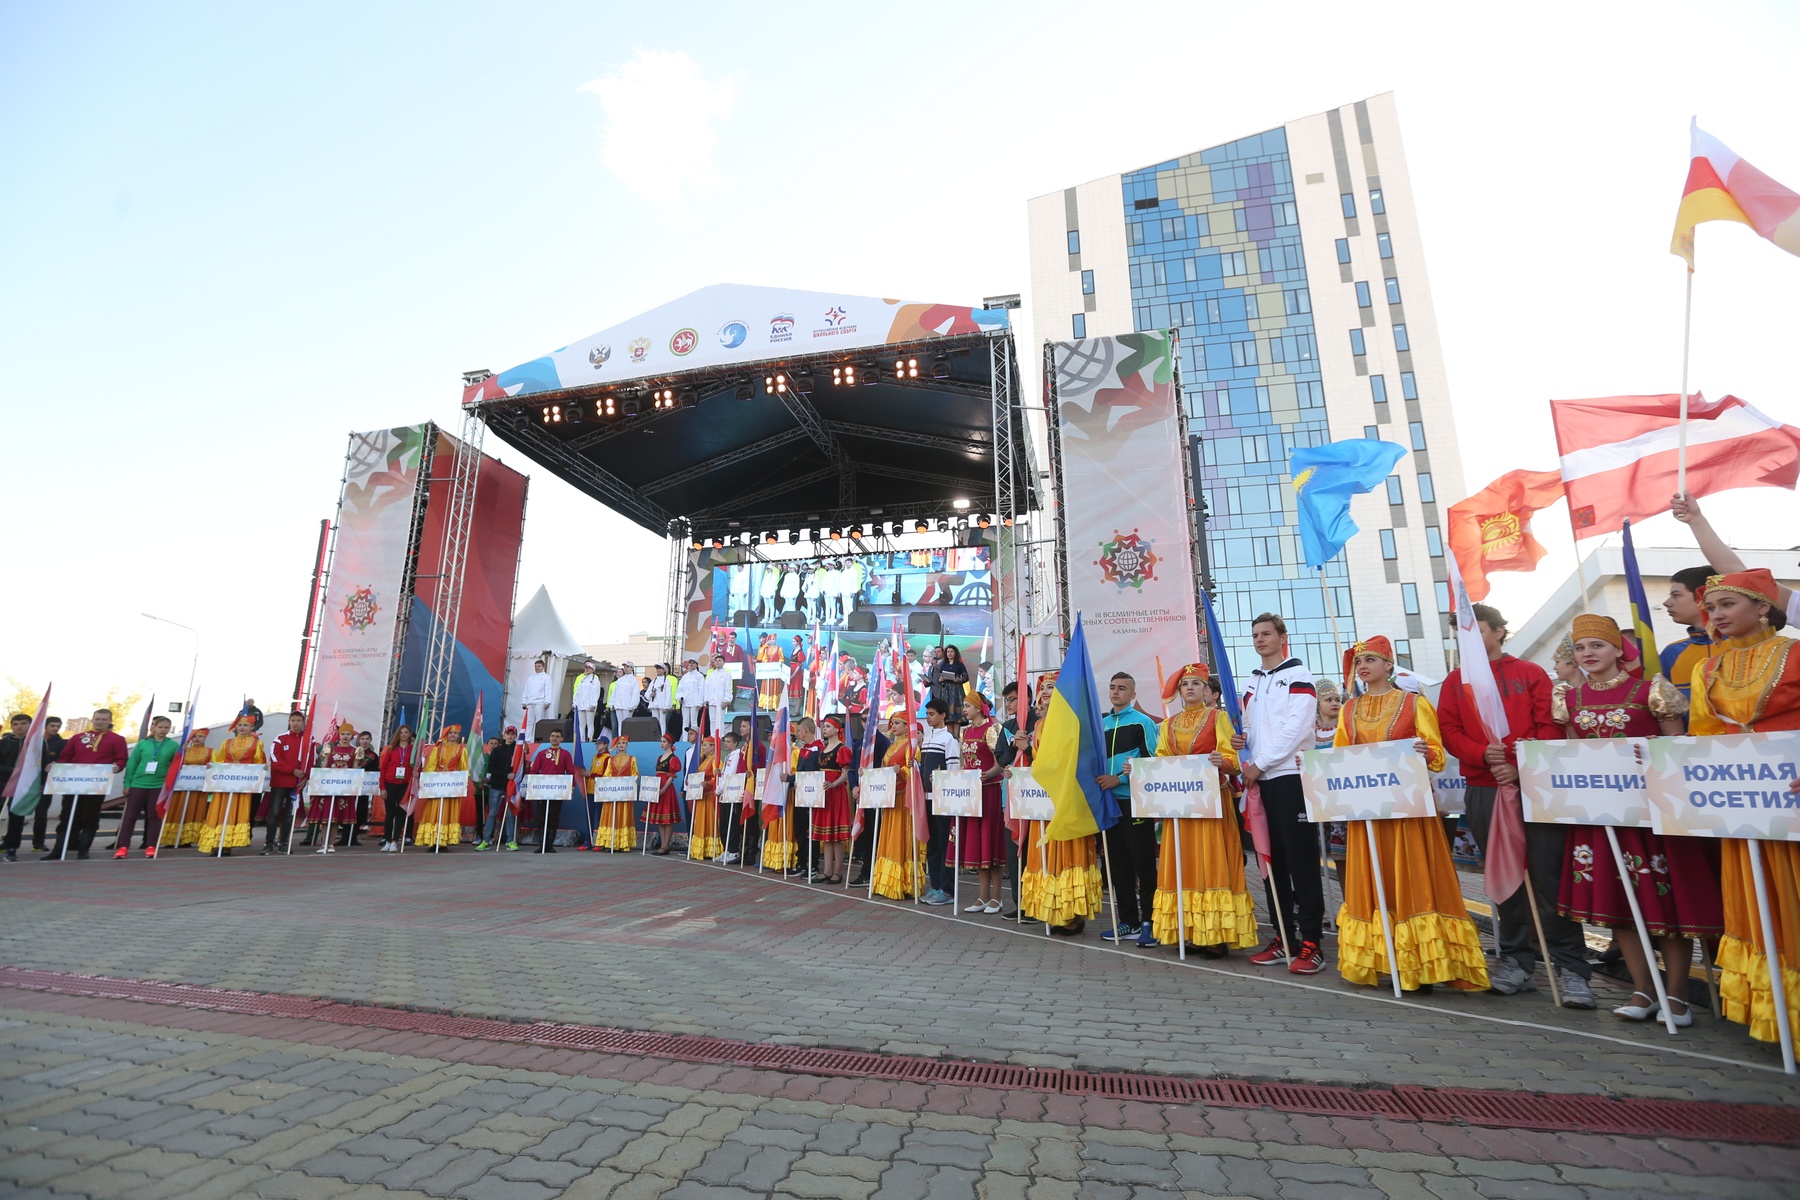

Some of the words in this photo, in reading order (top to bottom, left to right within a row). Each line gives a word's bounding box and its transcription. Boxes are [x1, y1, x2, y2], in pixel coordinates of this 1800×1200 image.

[1103, 610, 1148, 618] ВСЕМИРНЫЕ
[1150, 608, 1170, 616] ИГРЫ
[1104, 615, 1187, 625] СООТЕЧЕСТВЕННИКОВ
[1683, 762, 1798, 782] ЮЖНАЯ
[1144, 780, 1204, 794] ФРАНЦИЯ
[1326, 772, 1402, 791] МАЛЬТА
[869, 784, 887, 792] ТУНИС
[941, 788, 971, 798] ТУРЦИЯ
[1020, 788, 1050, 799] УКРАИ
[1689, 790, 1800, 809] ОСЕТИЯ
